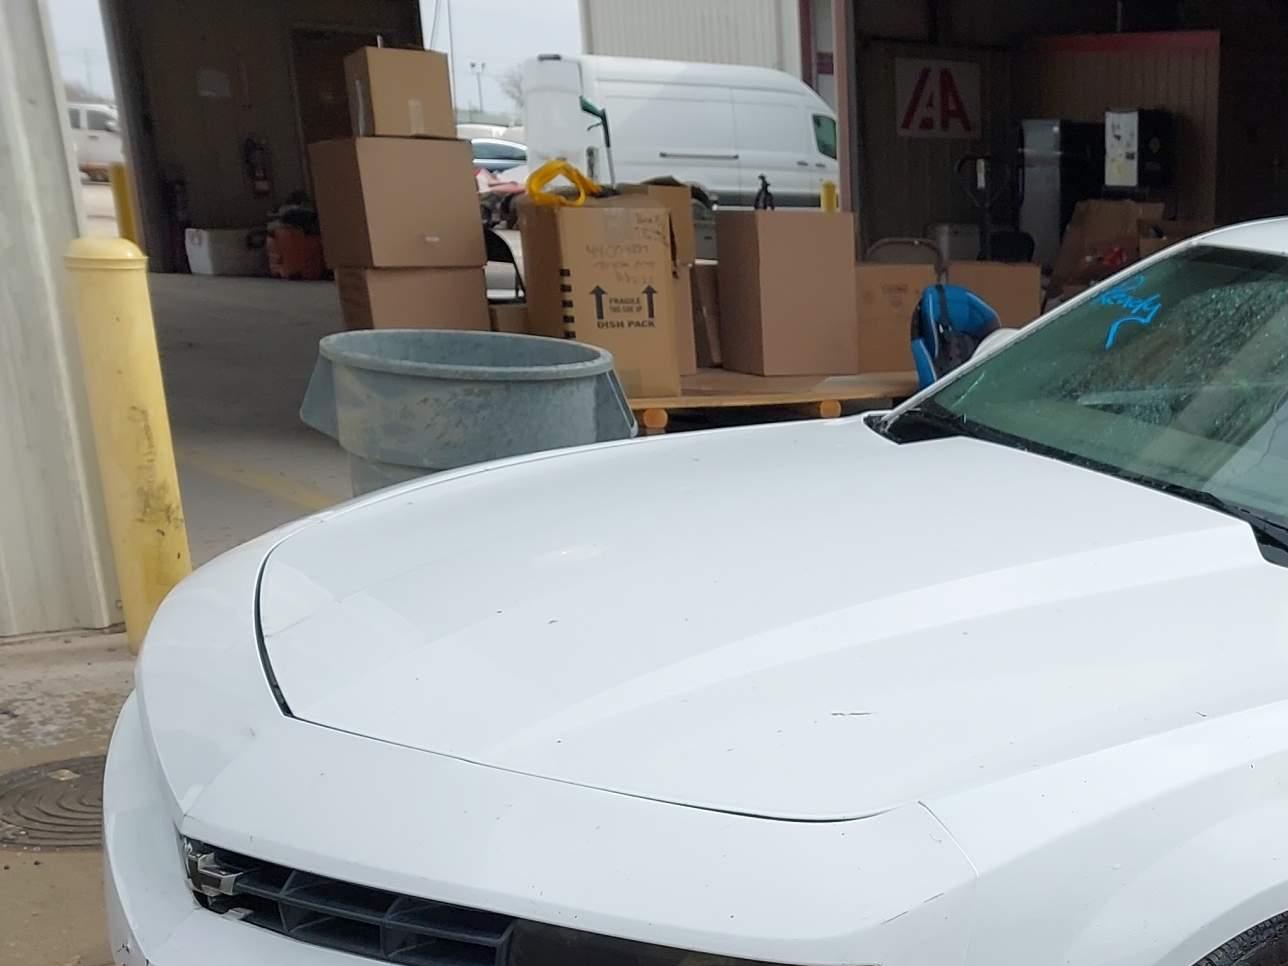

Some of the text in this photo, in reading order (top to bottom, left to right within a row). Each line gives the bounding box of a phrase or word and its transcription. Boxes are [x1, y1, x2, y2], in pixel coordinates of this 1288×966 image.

[608, 296, 641, 305] FRAGILE
[596, 319, 656, 329] DISH PACK
